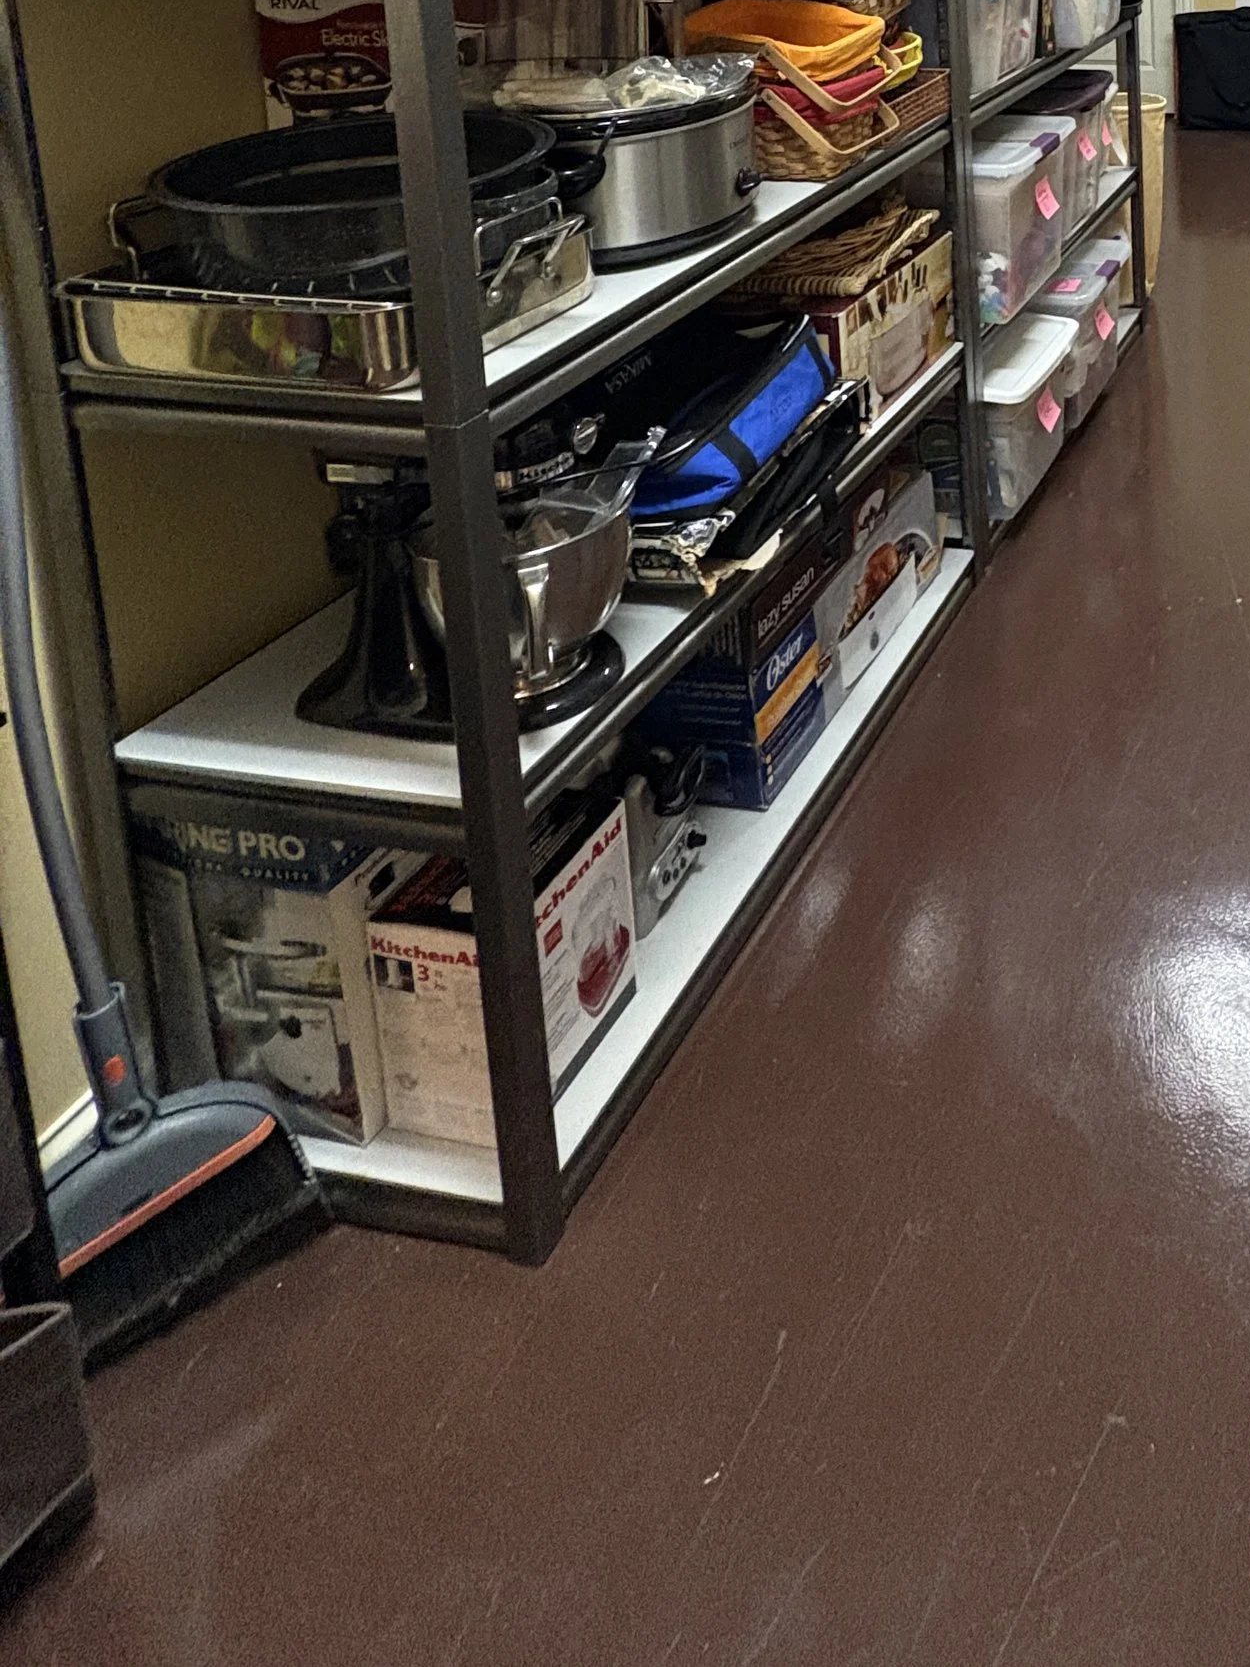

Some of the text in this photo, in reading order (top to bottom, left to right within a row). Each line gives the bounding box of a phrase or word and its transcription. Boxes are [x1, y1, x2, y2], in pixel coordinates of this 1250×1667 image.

[321, 28, 370, 46] Electric
[757, 566, 815, 641] lazy susan
[765, 631, 804, 692] Oster
[236, 828, 308, 863] PRO
[240, 866, 311, 883] QUALITY
[536, 816, 622, 930] tchenAid
[370, 935, 480, 968] KitchenAi
[416, 963, 430, 983] 3
